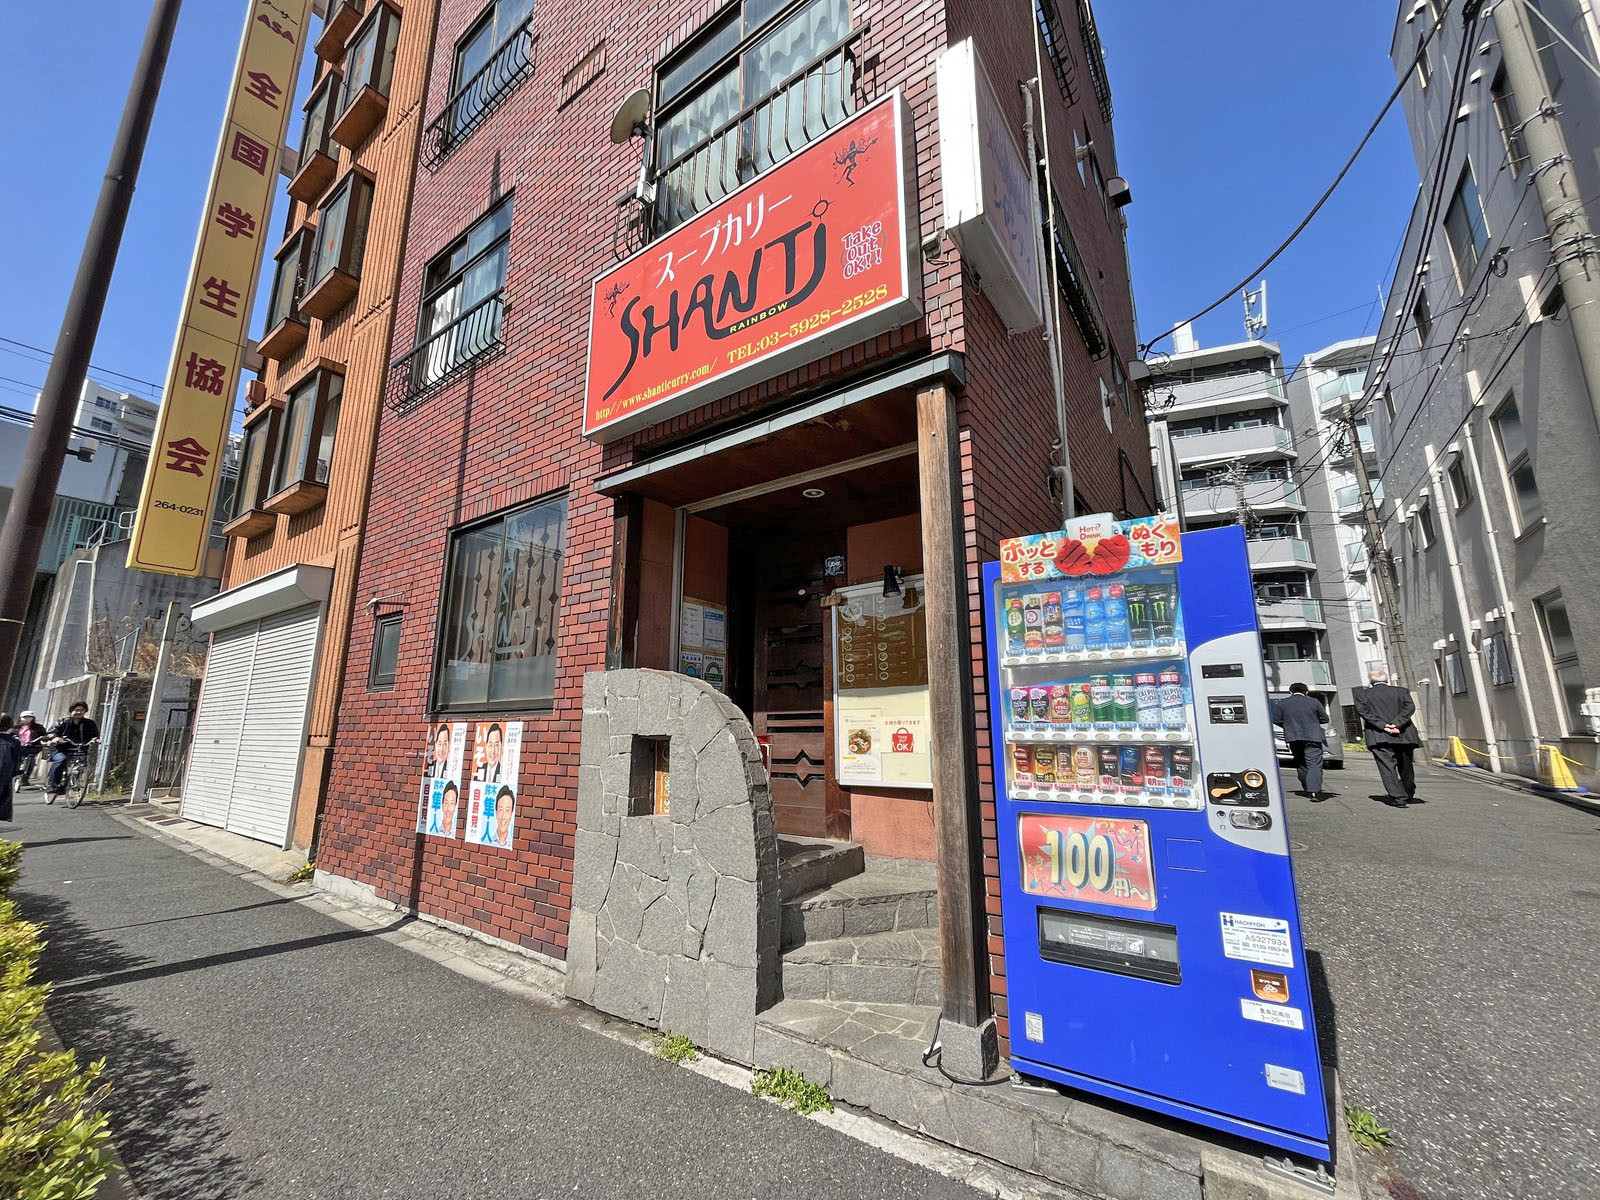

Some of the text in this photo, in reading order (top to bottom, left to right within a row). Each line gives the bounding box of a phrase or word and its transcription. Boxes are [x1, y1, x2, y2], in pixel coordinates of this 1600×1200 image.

[257, 14, 295, 45] ASA
[655, 193, 793, 289] スープカリー
[841, 221, 882, 250] Take
[165, 70, 282, 478] 全国学生協会
[729, 301, 789, 334] RAINBOW
[154, 500, 204, 516] 264-0231
[1131, 523, 1166, 541] ぬく
[1003, 541, 1057, 562] ホッと
[1141, 540, 1176, 558] もり
[1018, 561, 1046, 576] する
[896, 743, 909, 751] OK
[471, 788, 480, 829] 自民党
[1245, 934, 1287, 946] AS327934
